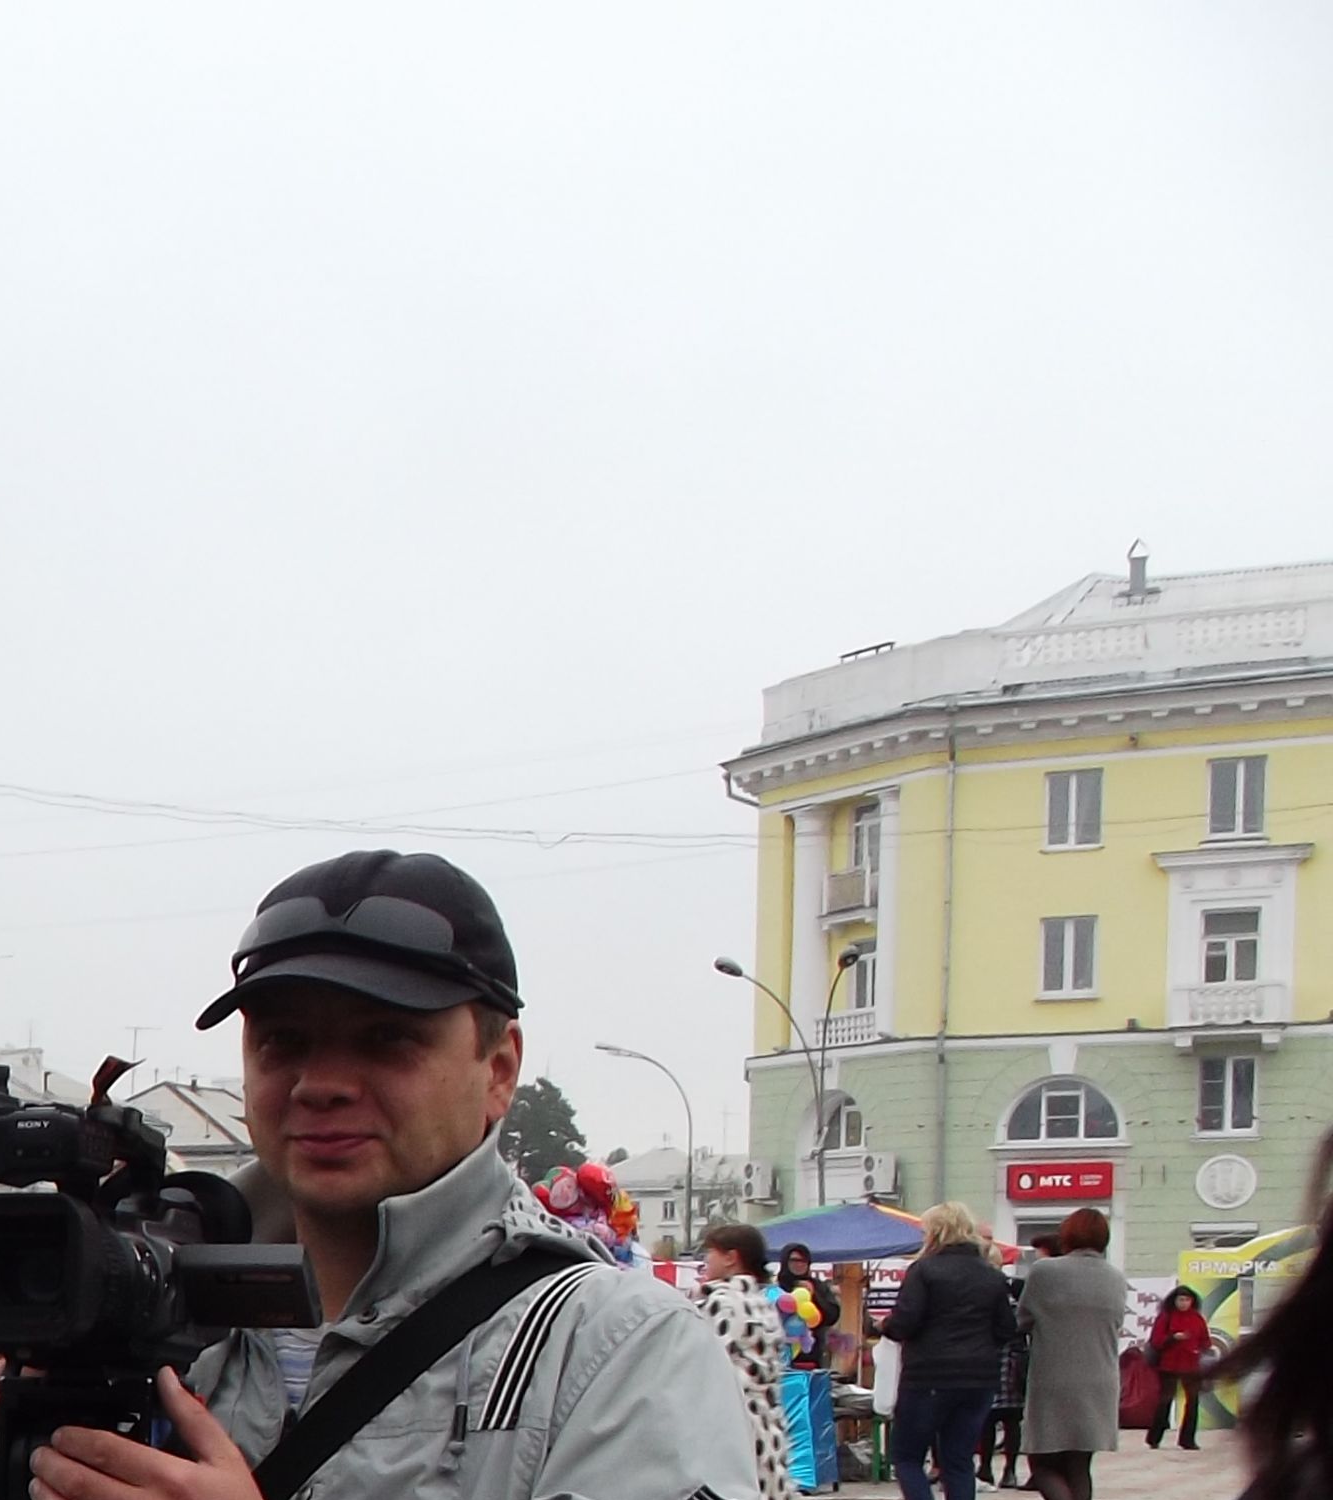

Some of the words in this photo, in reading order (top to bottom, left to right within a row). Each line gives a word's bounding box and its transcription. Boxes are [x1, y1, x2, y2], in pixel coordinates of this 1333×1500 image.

[17, 1121, 50, 1129] SONY
[1039, 1175, 1072, 1187] МТС
[1188, 1260, 1278, 1275] ЯРМАРКА
